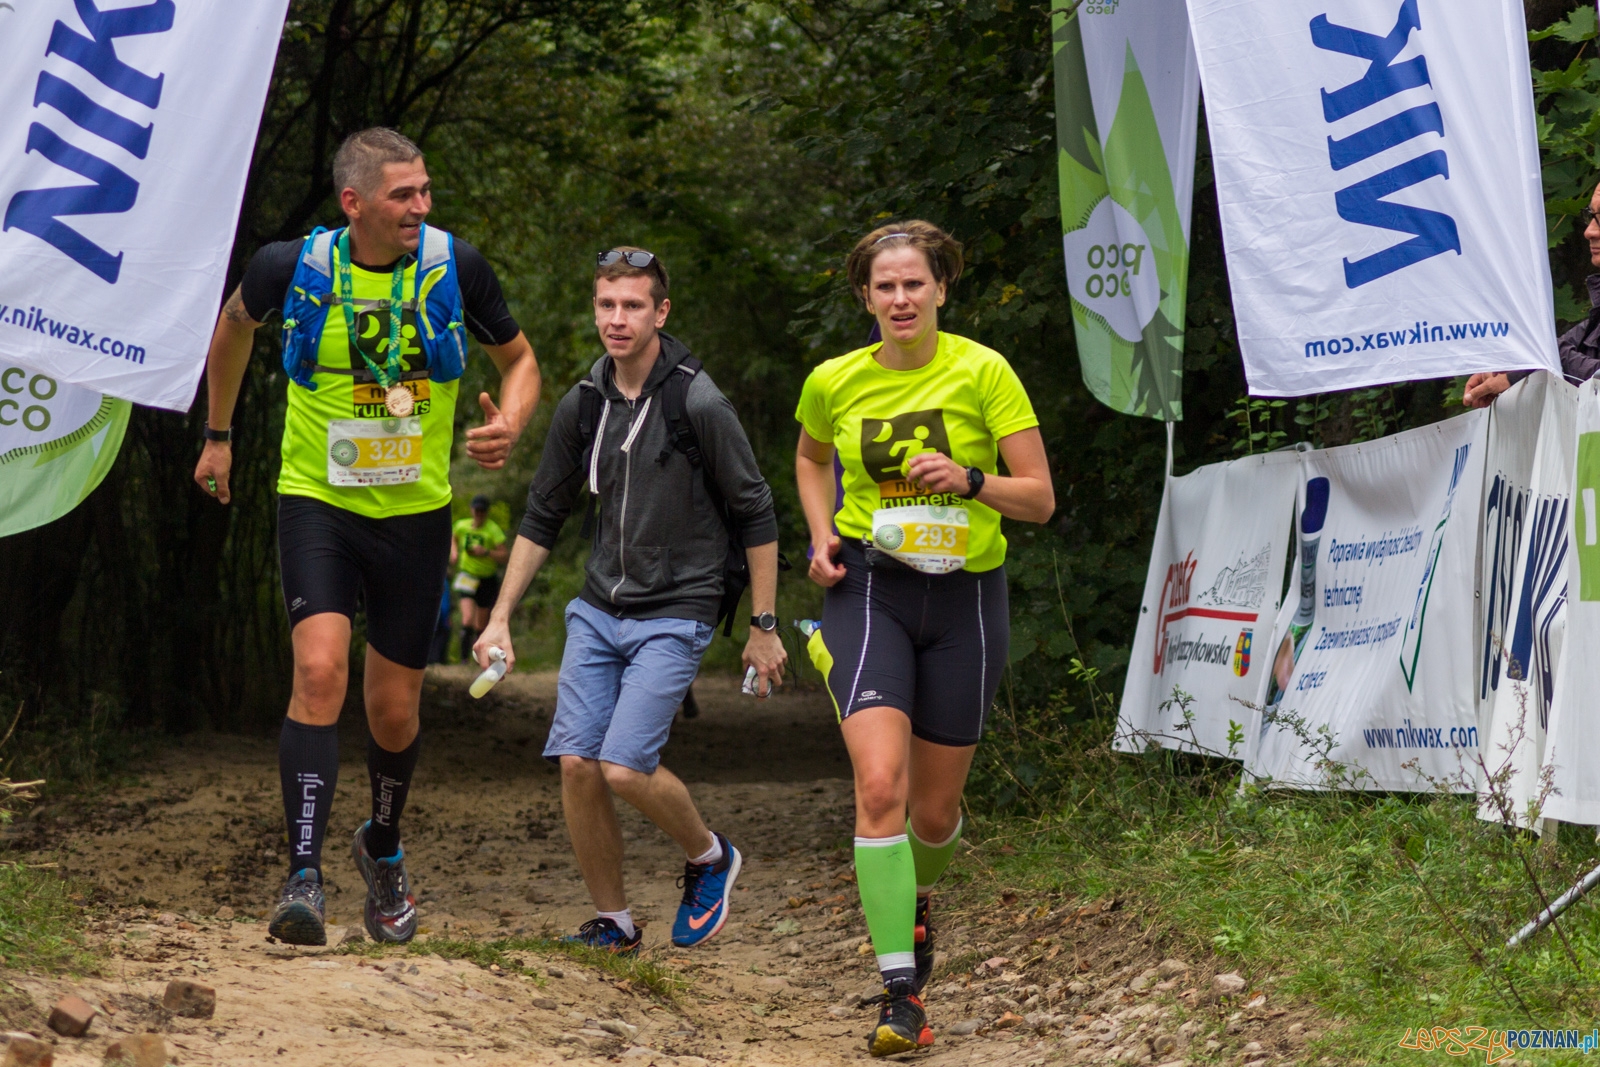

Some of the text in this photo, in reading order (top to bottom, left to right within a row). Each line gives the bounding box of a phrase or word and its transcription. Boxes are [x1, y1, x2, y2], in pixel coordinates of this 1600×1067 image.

[354, 400, 430, 417] runrs
[369, 439, 412, 461] 320
[914, 525, 957, 548] 293
